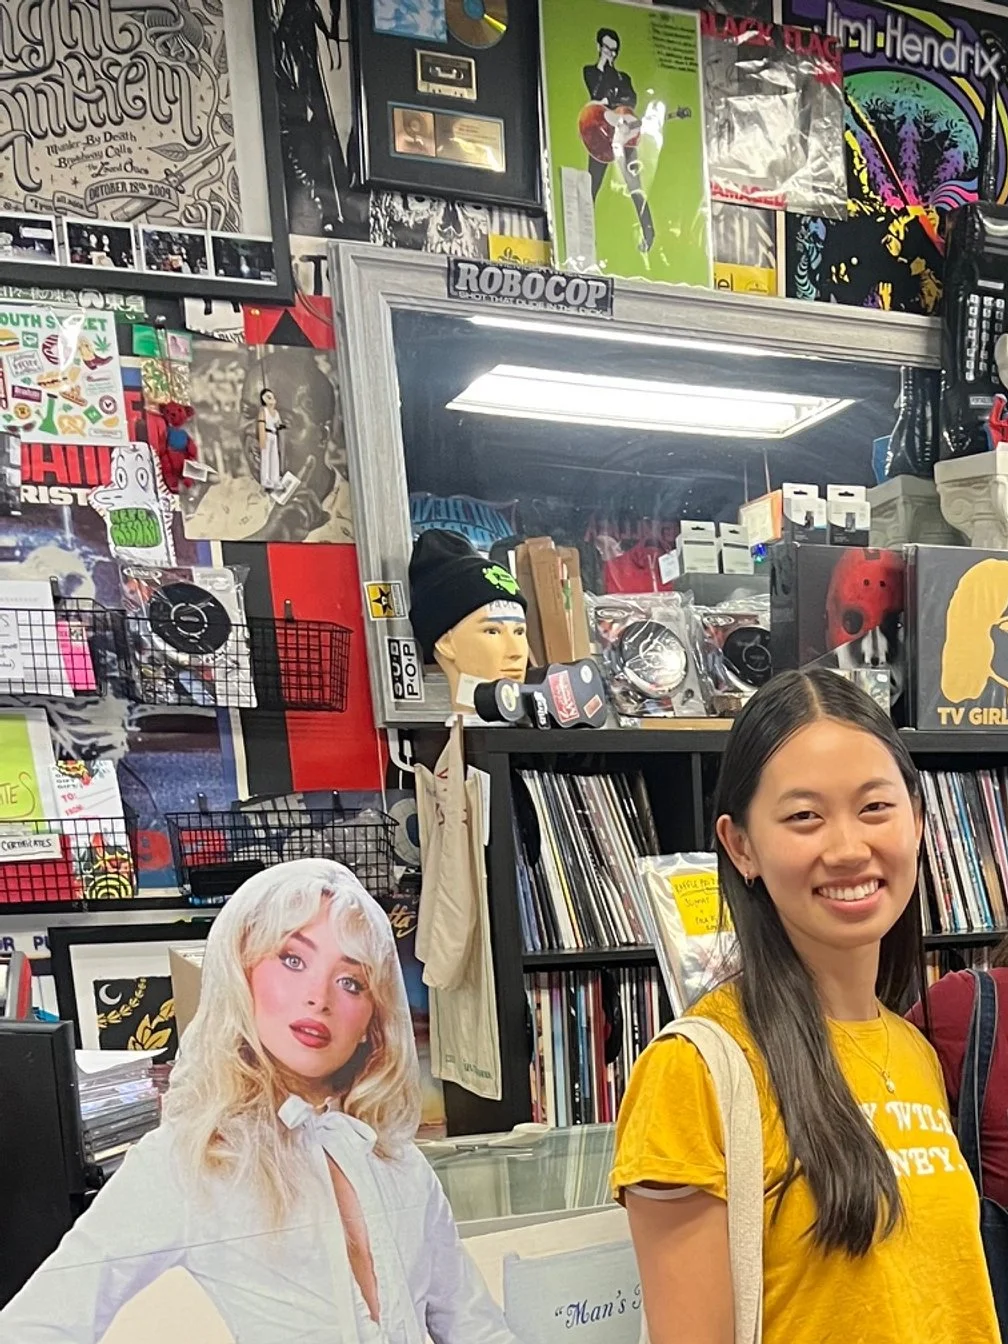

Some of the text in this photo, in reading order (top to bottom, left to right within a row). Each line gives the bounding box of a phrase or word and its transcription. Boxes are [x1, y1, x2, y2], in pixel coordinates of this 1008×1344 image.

[885, 12, 1001, 81] Hendrix
[82, 134, 102, 150] By
[103, 130, 137, 144] Death
[105, 144, 133, 159] Calls
[89, 181, 127, 200] OCTOBER
[148, 184, 172, 200] 2009
[710, 180, 788, 209] AMAGED
[455, 262, 607, 308] ROBOCOP
[0, 313, 108, 332] OUTH SEET
[937, 706, 965, 726] TV
